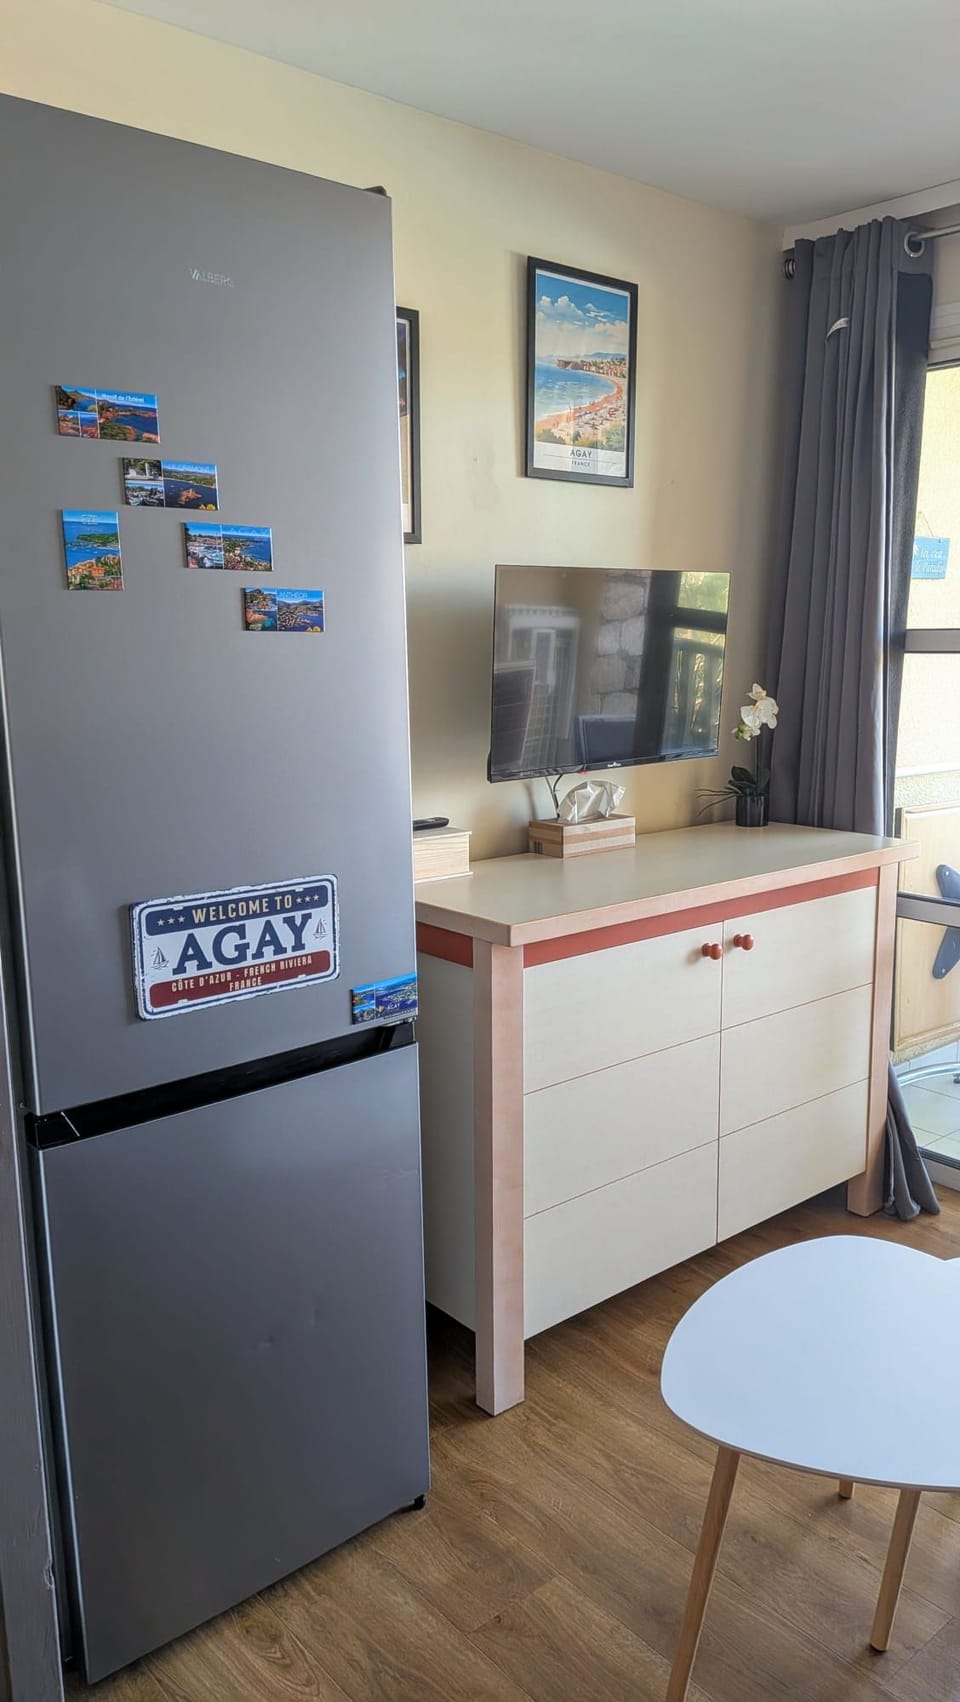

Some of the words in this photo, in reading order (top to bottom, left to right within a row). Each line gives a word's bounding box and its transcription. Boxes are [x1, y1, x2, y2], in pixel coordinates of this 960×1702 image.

[570, 449, 592, 458] AGAY
[192, 898, 269, 924] WELCOME
[275, 894, 292, 910] TO
[172, 912, 312, 975] AGAY
[171, 979, 195, 992] CÔTE
[199, 972, 232, 987] D'AZUR
[244, 962, 276, 978] FRENCH
[280, 955, 312, 970] RIVIERA
[229, 976, 263, 992] FRANCE
